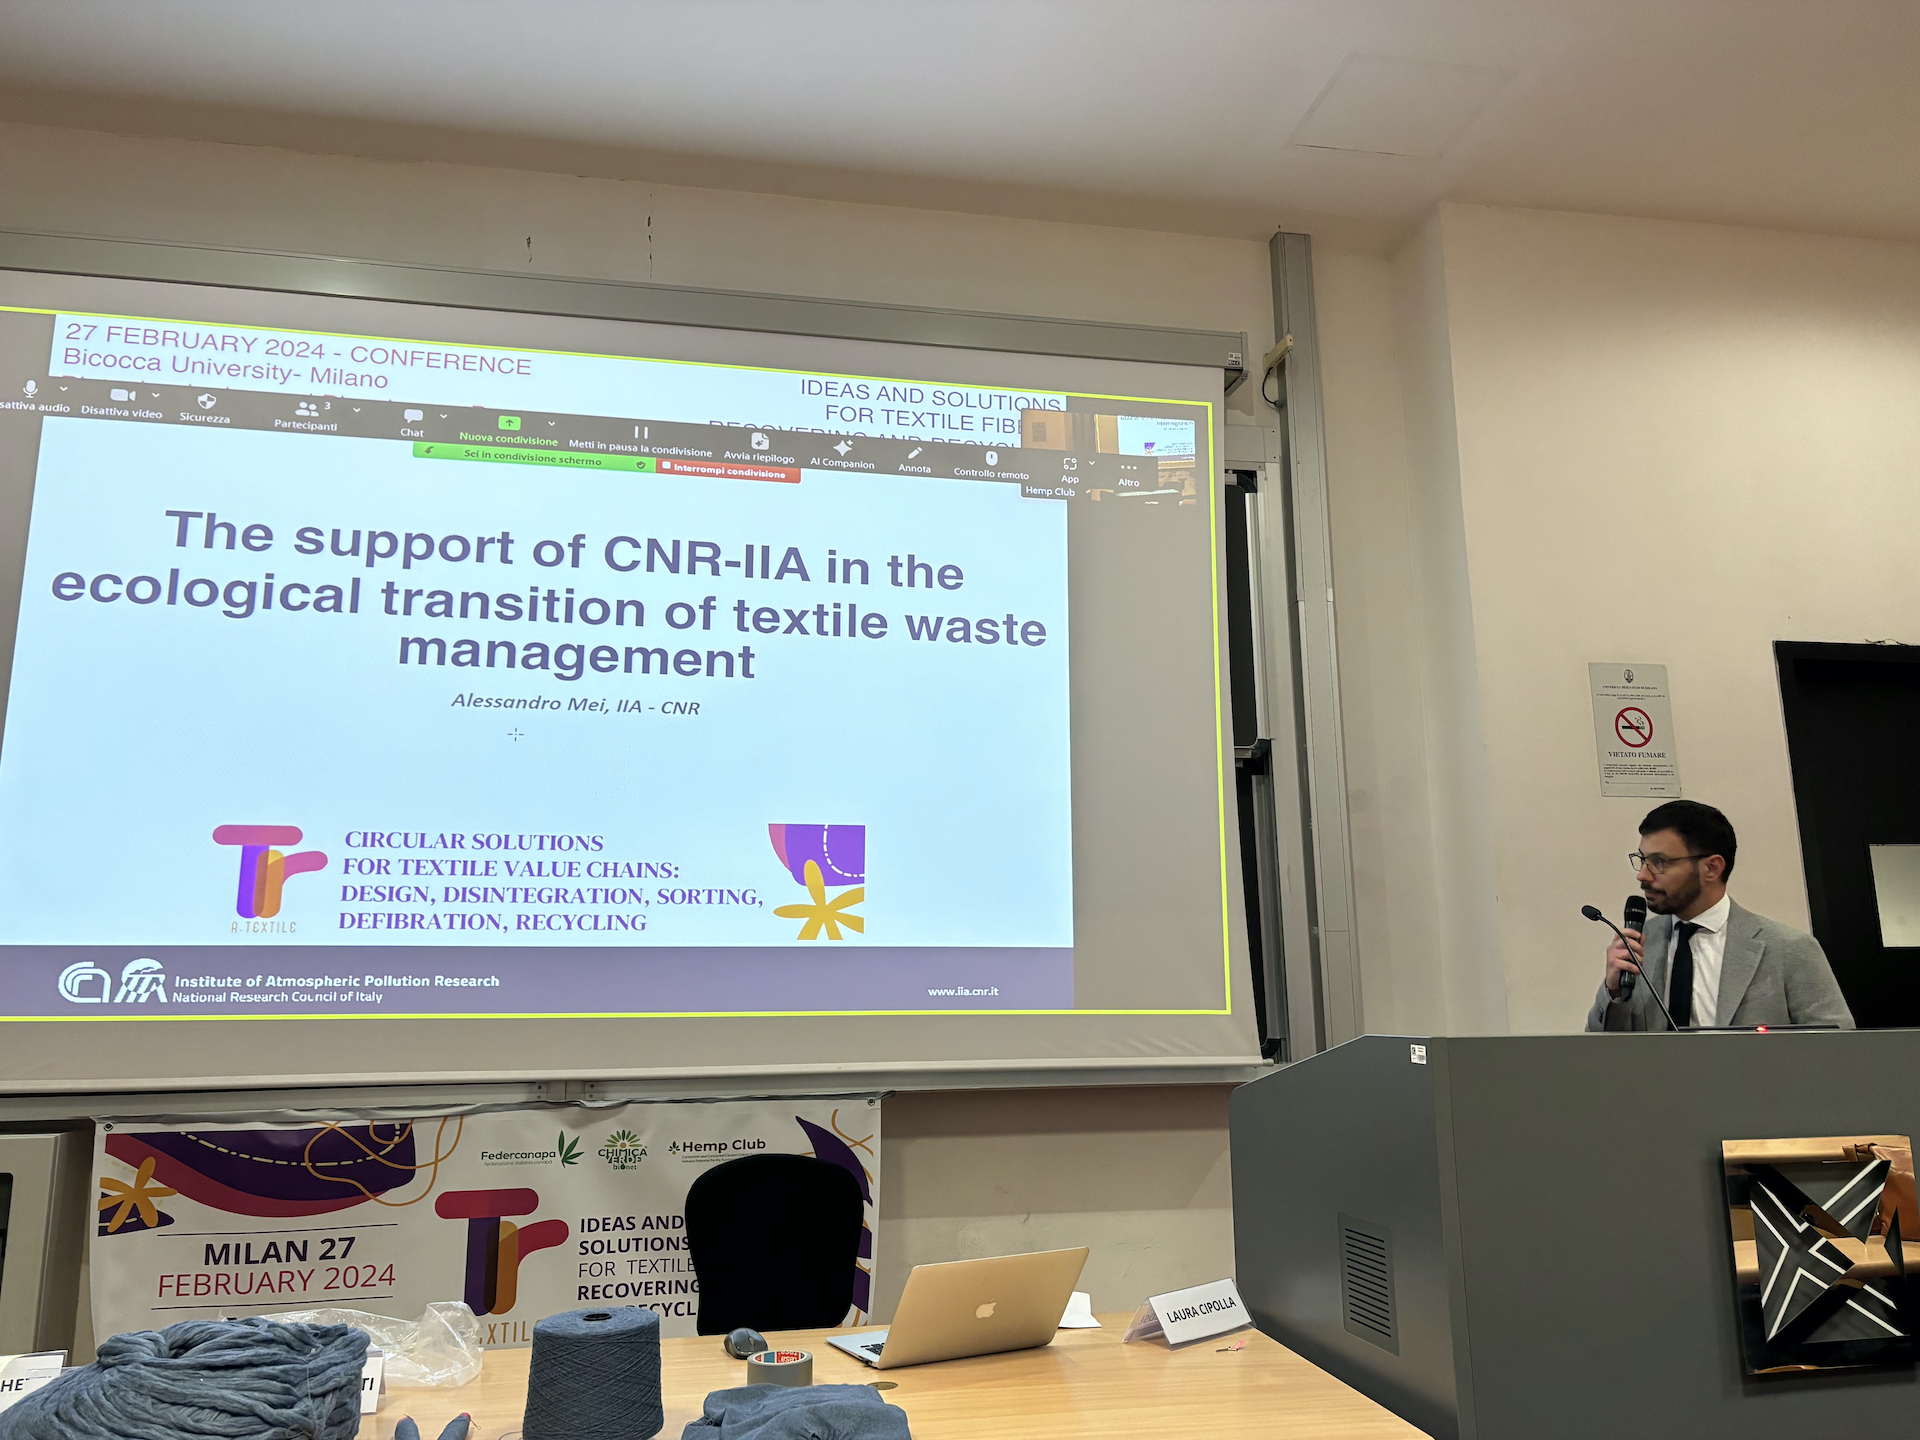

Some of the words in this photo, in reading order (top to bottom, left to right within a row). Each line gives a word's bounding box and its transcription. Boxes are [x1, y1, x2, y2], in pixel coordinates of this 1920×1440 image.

[65, 323, 98, 341] 27
[106, 326, 258, 353] FEBRUARY
[265, 339, 325, 359] 2024
[350, 346, 532, 376] CONFERENCE
[63, 347, 162, 372] Bicocca
[171, 355, 301, 385] University-
[310, 366, 389, 389] Milano
[800, 379, 870, 400] IDEAS
[876, 385, 924, 404] AND
[931, 390, 1062, 411] SOLUTIONS
[38, 403, 71, 413] audio
[81, 405, 129, 417] Disattiva
[132, 408, 163, 419] video
[324, 401, 331, 410] 3
[179, 411, 231, 424] Sicurezza
[274, 418, 338, 432] Partecipanti
[825, 404, 874, 424] FOR
[881, 408, 974, 431] TEXTILE
[982, 416, 1021, 434] FIB
[400, 428, 424, 438] Chat
[459, 431, 494, 443] Nuova
[496, 435, 559, 447] condivisione
[569, 439, 596, 450] Metti
[597, 440, 607, 451] in
[609, 443, 639, 454] pausa
[641, 443, 650, 453] la
[652, 446, 713, 458] condivisione
[464, 449, 479, 458] Sei
[481, 450, 492, 459] in
[493, 451, 557, 463] condivisione
[559, 456, 602, 466] schermo
[723, 451, 750, 461] Avvia
[752, 452, 795, 466] riepilogo
[810, 458, 821, 466] AI
[822, 458, 875, 470] Companion
[673, 463, 725, 476] Interrompi
[727, 467, 786, 479] condivisione
[898, 463, 932, 474] Annota
[954, 467, 995, 478] Controllo
[997, 471, 1030, 481] remoto
[1061, 475, 1079, 485] App
[1118, 478, 1140, 488] Altro
[1026, 486, 1053, 496] Hemp
[1055, 487, 1075, 497] Club
[165, 509, 274, 553] The
[294, 526, 514, 570] support
[532, 534, 586, 569] of
[604, 535, 811, 582] CNR-IIA
[827, 549, 870, 585] in
[887, 554, 965, 591] the
[51, 567, 361, 619] ecological
[381, 581, 646, 628] transition
[664, 596, 717, 631] of
[733, 599, 888, 640] textile
[904, 612, 1048, 647] waste
[399, 636, 755, 682] management
[450, 693, 561, 711] Alessandro
[567, 697, 610, 716] Mei,
[615, 699, 643, 714] IIA
[660, 700, 702, 716] CNR
[1608, 751, 1637, 759] VIETATO
[1638, 751, 1667, 759] FUMARE
[345, 831, 466, 850] CIRCULAR
[471, 833, 604, 852] SOLUTIONS
[342, 858, 391, 876] FOR
[398, 858, 498, 877] TEXTILE
[503, 859, 581, 879] VALUE
[586, 861, 680, 879] CHAINS:
[340, 885, 436, 906] DESIGN,
[443, 885, 651, 908] DISINTEGRATION,
[656, 888, 764, 909] SORTING,
[338, 912, 508, 934] DEFIBRATION,
[516, 913, 647, 932] RECYCLING
[175, 975, 242, 989] Institute
[245, 974, 264, 988] of
[265, 974, 361, 991] Atmospheric
[364, 974, 430, 988] Pollution
[434, 974, 500, 988] Research
[172, 990, 226, 1003] National
[230, 990, 289, 1003] Research
[291, 990, 337, 1003] Council
[339, 990, 354, 1003] of
[355, 991, 383, 1004] Italy
[928, 986, 999, 997] www.iia.cnr.it
[597, 1148, 648, 1157] CHIMICA
[682, 1141, 728, 1153] Hemp
[732, 1138, 767, 1150] Club
[481, 1151, 556, 1161] Federcanapa
[605, 1156, 642, 1164] VERDE
[580, 1216, 636, 1233] IDEAS
[641, 1215, 684, 1230] AND
[204, 1240, 308, 1266] MILAN
[318, 1236, 356, 1261] 27
[579, 1236, 690, 1255] SOLUTIONS
[579, 1261, 616, 1278] FOR
[626, 1258, 696, 1275] TEXTILE
[158, 1268, 316, 1297] FEBRUARY
[323, 1263, 396, 1291] 2024
[577, 1279, 700, 1301] RECOVERING
[1166, 1306, 1200, 1323] LAURA
[1199, 1296, 1237, 1315] CIPOLLA
[479, 1320, 531, 1345] XTIL
